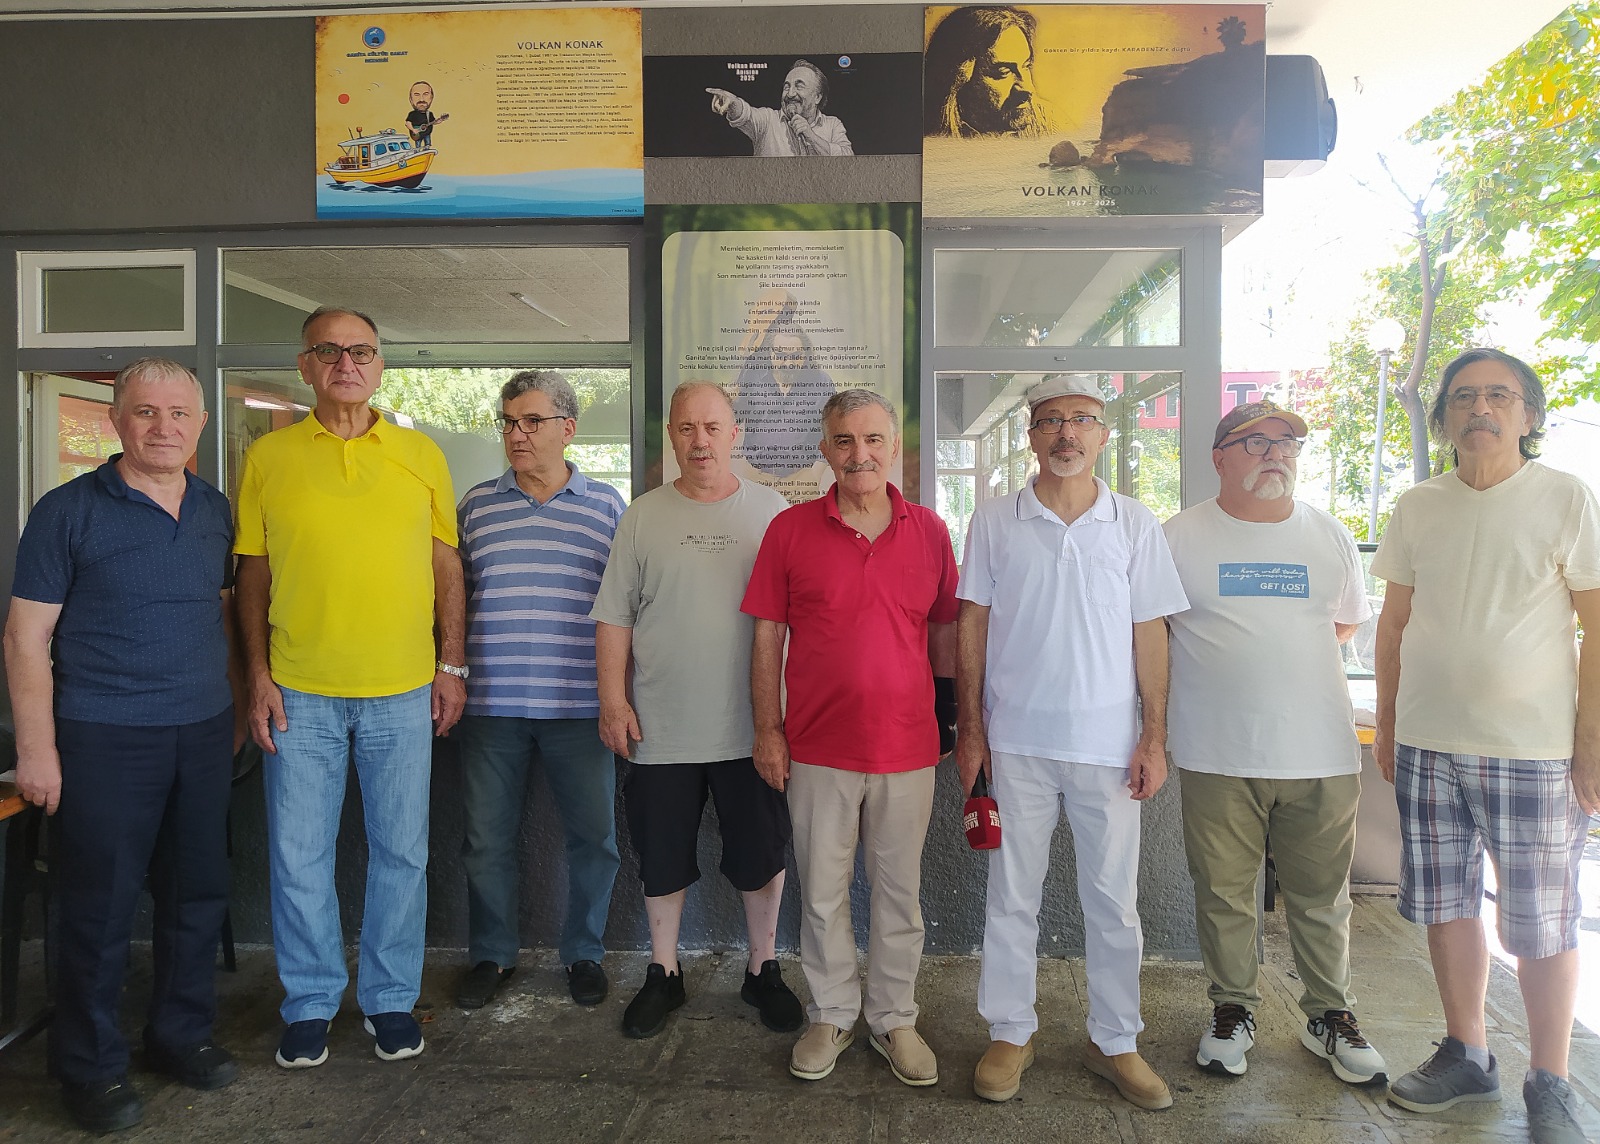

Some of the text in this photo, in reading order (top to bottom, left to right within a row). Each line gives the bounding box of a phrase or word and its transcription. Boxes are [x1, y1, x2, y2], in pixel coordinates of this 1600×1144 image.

[517, 40, 604, 50] VOLKAN KONAK
[1022, 185, 1159, 197] VOLKAN KONAK
[736, 263, 744, 271] Ne
[772, 263, 794, 271] taşımış
[795, 263, 829, 271] ayakkabım
[717, 272, 729, 280] Son
[759, 272, 768, 280] da
[769, 272, 794, 280] sırtımda
[826, 272, 848, 280] çoktan
[785, 309, 816, 317] yüreğimin
[743, 318, 752, 326] Ve
[844, 381, 852, 389] bir
[854, 381, 875, 389] yerden
[786, 390, 806, 398] denize
[808, 390, 821, 398] inen
[767, 408, 781, 416] öten
[745, 426, 787, 434] düşünüyorum
[789, 426, 808, 434] Orhan
[767, 444, 790, 452] yağmur
[791, 444, 803, 452] çisil
[756, 453, 790, 461] yürüyorsun
[792, 453, 800, 461] ya
[1282, 569, 1306, 577] today
[1281, 583, 1307, 591] LOST
